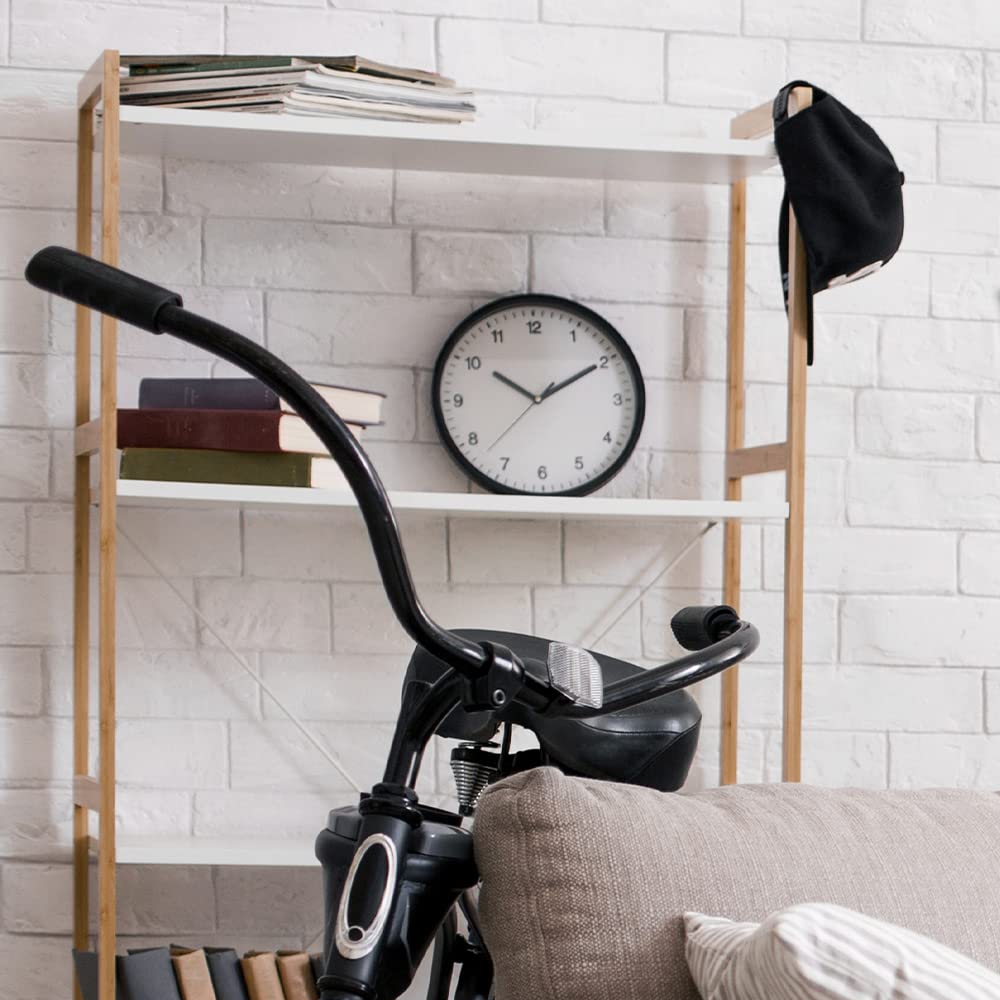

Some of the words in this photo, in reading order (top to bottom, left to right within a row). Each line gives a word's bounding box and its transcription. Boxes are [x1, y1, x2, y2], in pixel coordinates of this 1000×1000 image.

[526, 320, 542, 335] 12
[491, 329, 504, 343] 11
[569, 330, 576, 342] 1
[465, 355, 481, 370] 10
[599, 355, 609, 369] 2
[453, 394, 463, 408] 9
[613, 393, 622, 406] 3
[468, 432, 478, 446] 8
[602, 431, 612, 443] 4
[500, 457, 510, 471] 7
[574, 456, 584, 470] 5
[537, 466, 548, 480] 6
